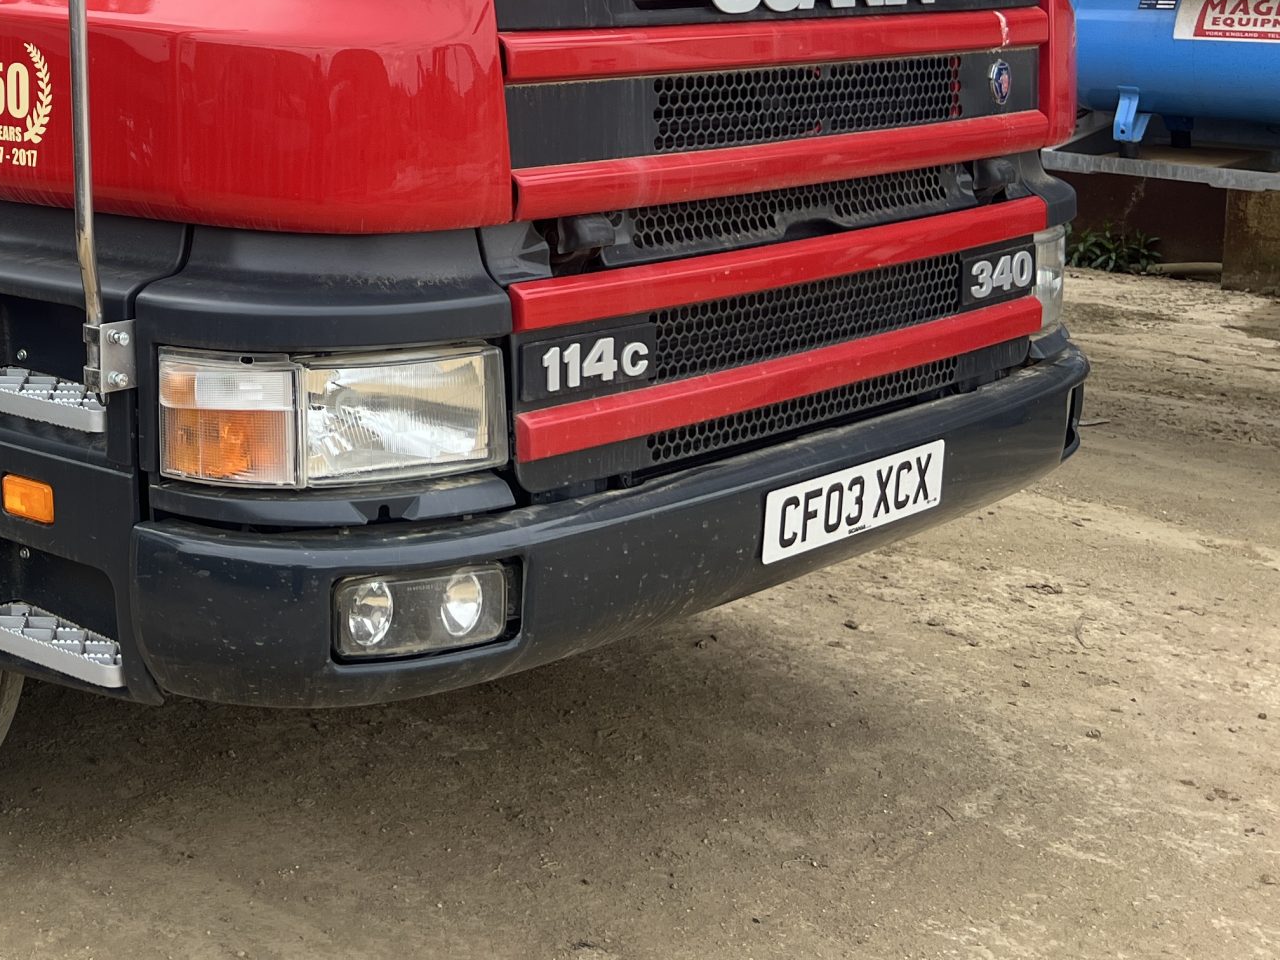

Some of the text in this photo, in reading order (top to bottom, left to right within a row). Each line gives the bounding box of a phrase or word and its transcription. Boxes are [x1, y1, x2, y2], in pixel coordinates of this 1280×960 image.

[12, 147, 38, 167] 2017
[969, 249, 1034, 299] 340
[778, 453, 932, 549] CF03 XCX
